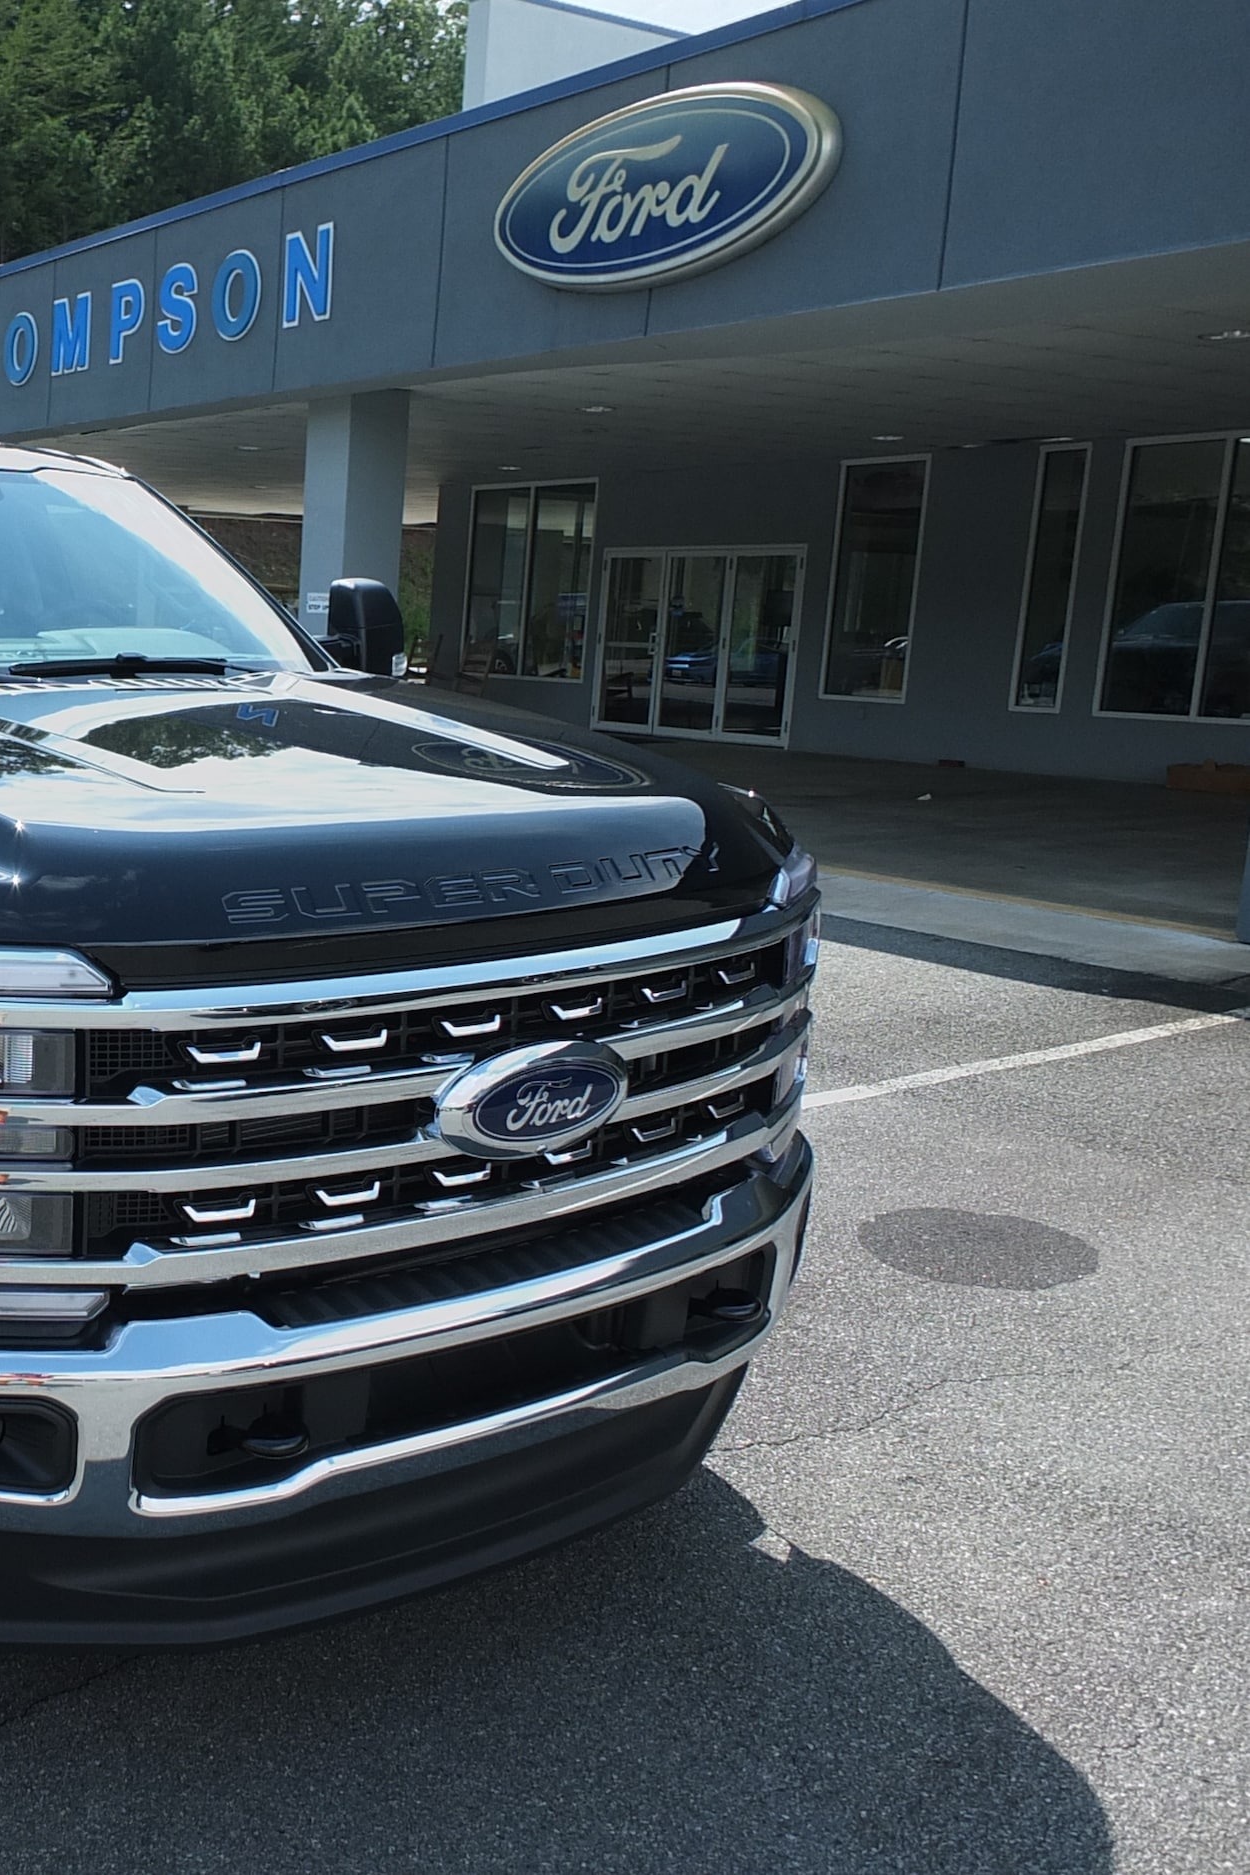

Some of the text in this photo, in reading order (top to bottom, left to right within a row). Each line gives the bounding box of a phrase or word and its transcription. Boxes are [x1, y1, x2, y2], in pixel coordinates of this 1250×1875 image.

[549, 134, 730, 254] Ford
[220, 841, 722, 925] SUPER DUTY
[506, 1076, 594, 1132] Ford
